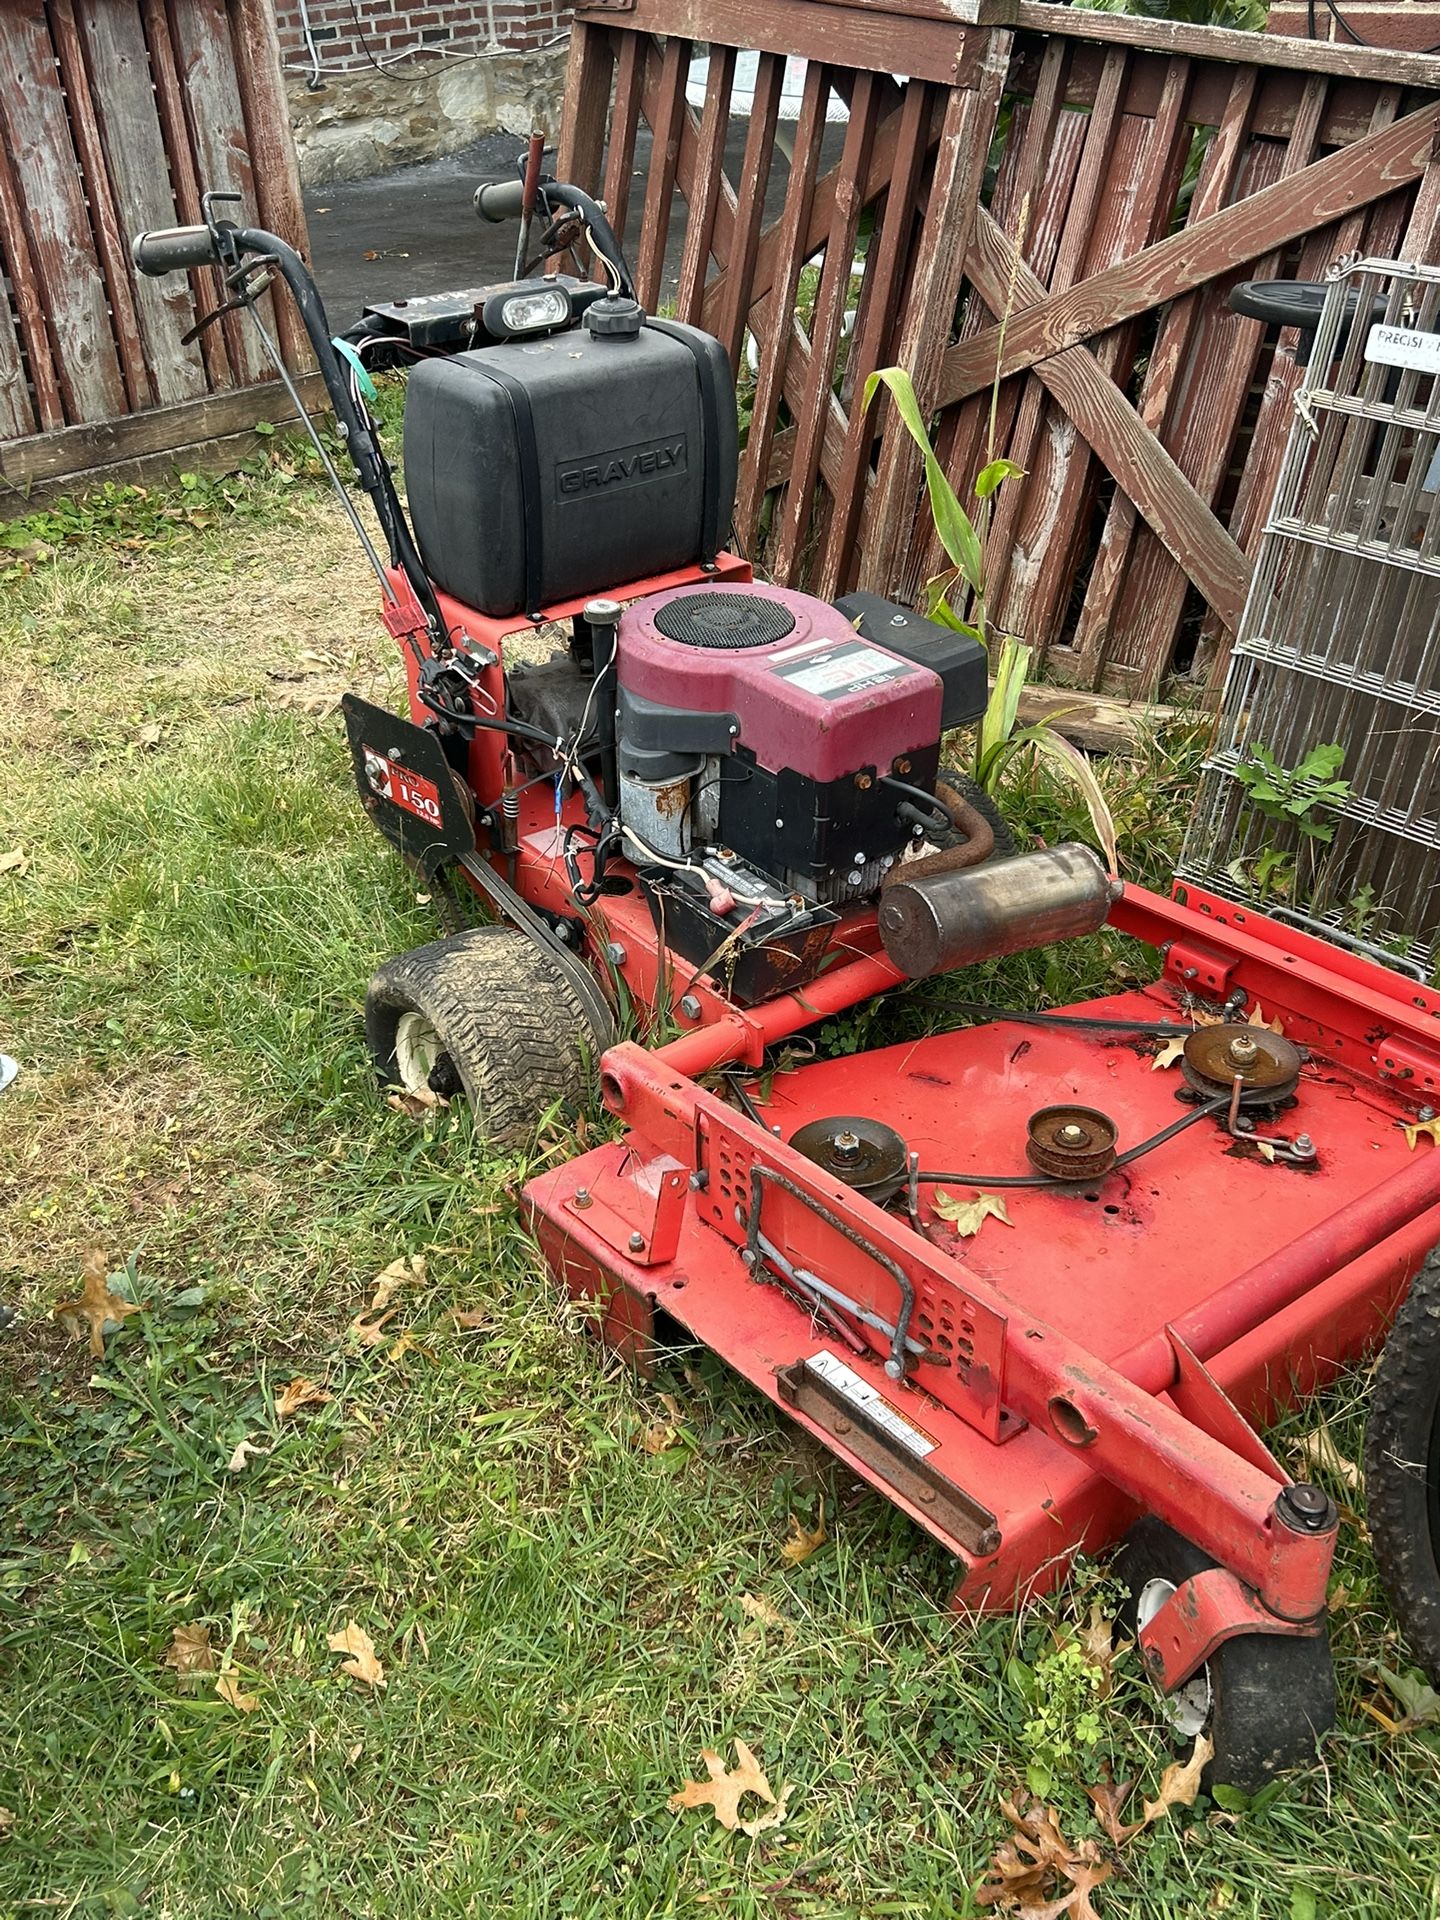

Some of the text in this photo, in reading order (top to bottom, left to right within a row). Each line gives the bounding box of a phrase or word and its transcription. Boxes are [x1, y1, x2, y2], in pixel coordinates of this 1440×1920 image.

[560, 443, 683, 493] GRAVELY
[391, 767, 420, 788] PRO
[399, 784, 440, 817] 150
